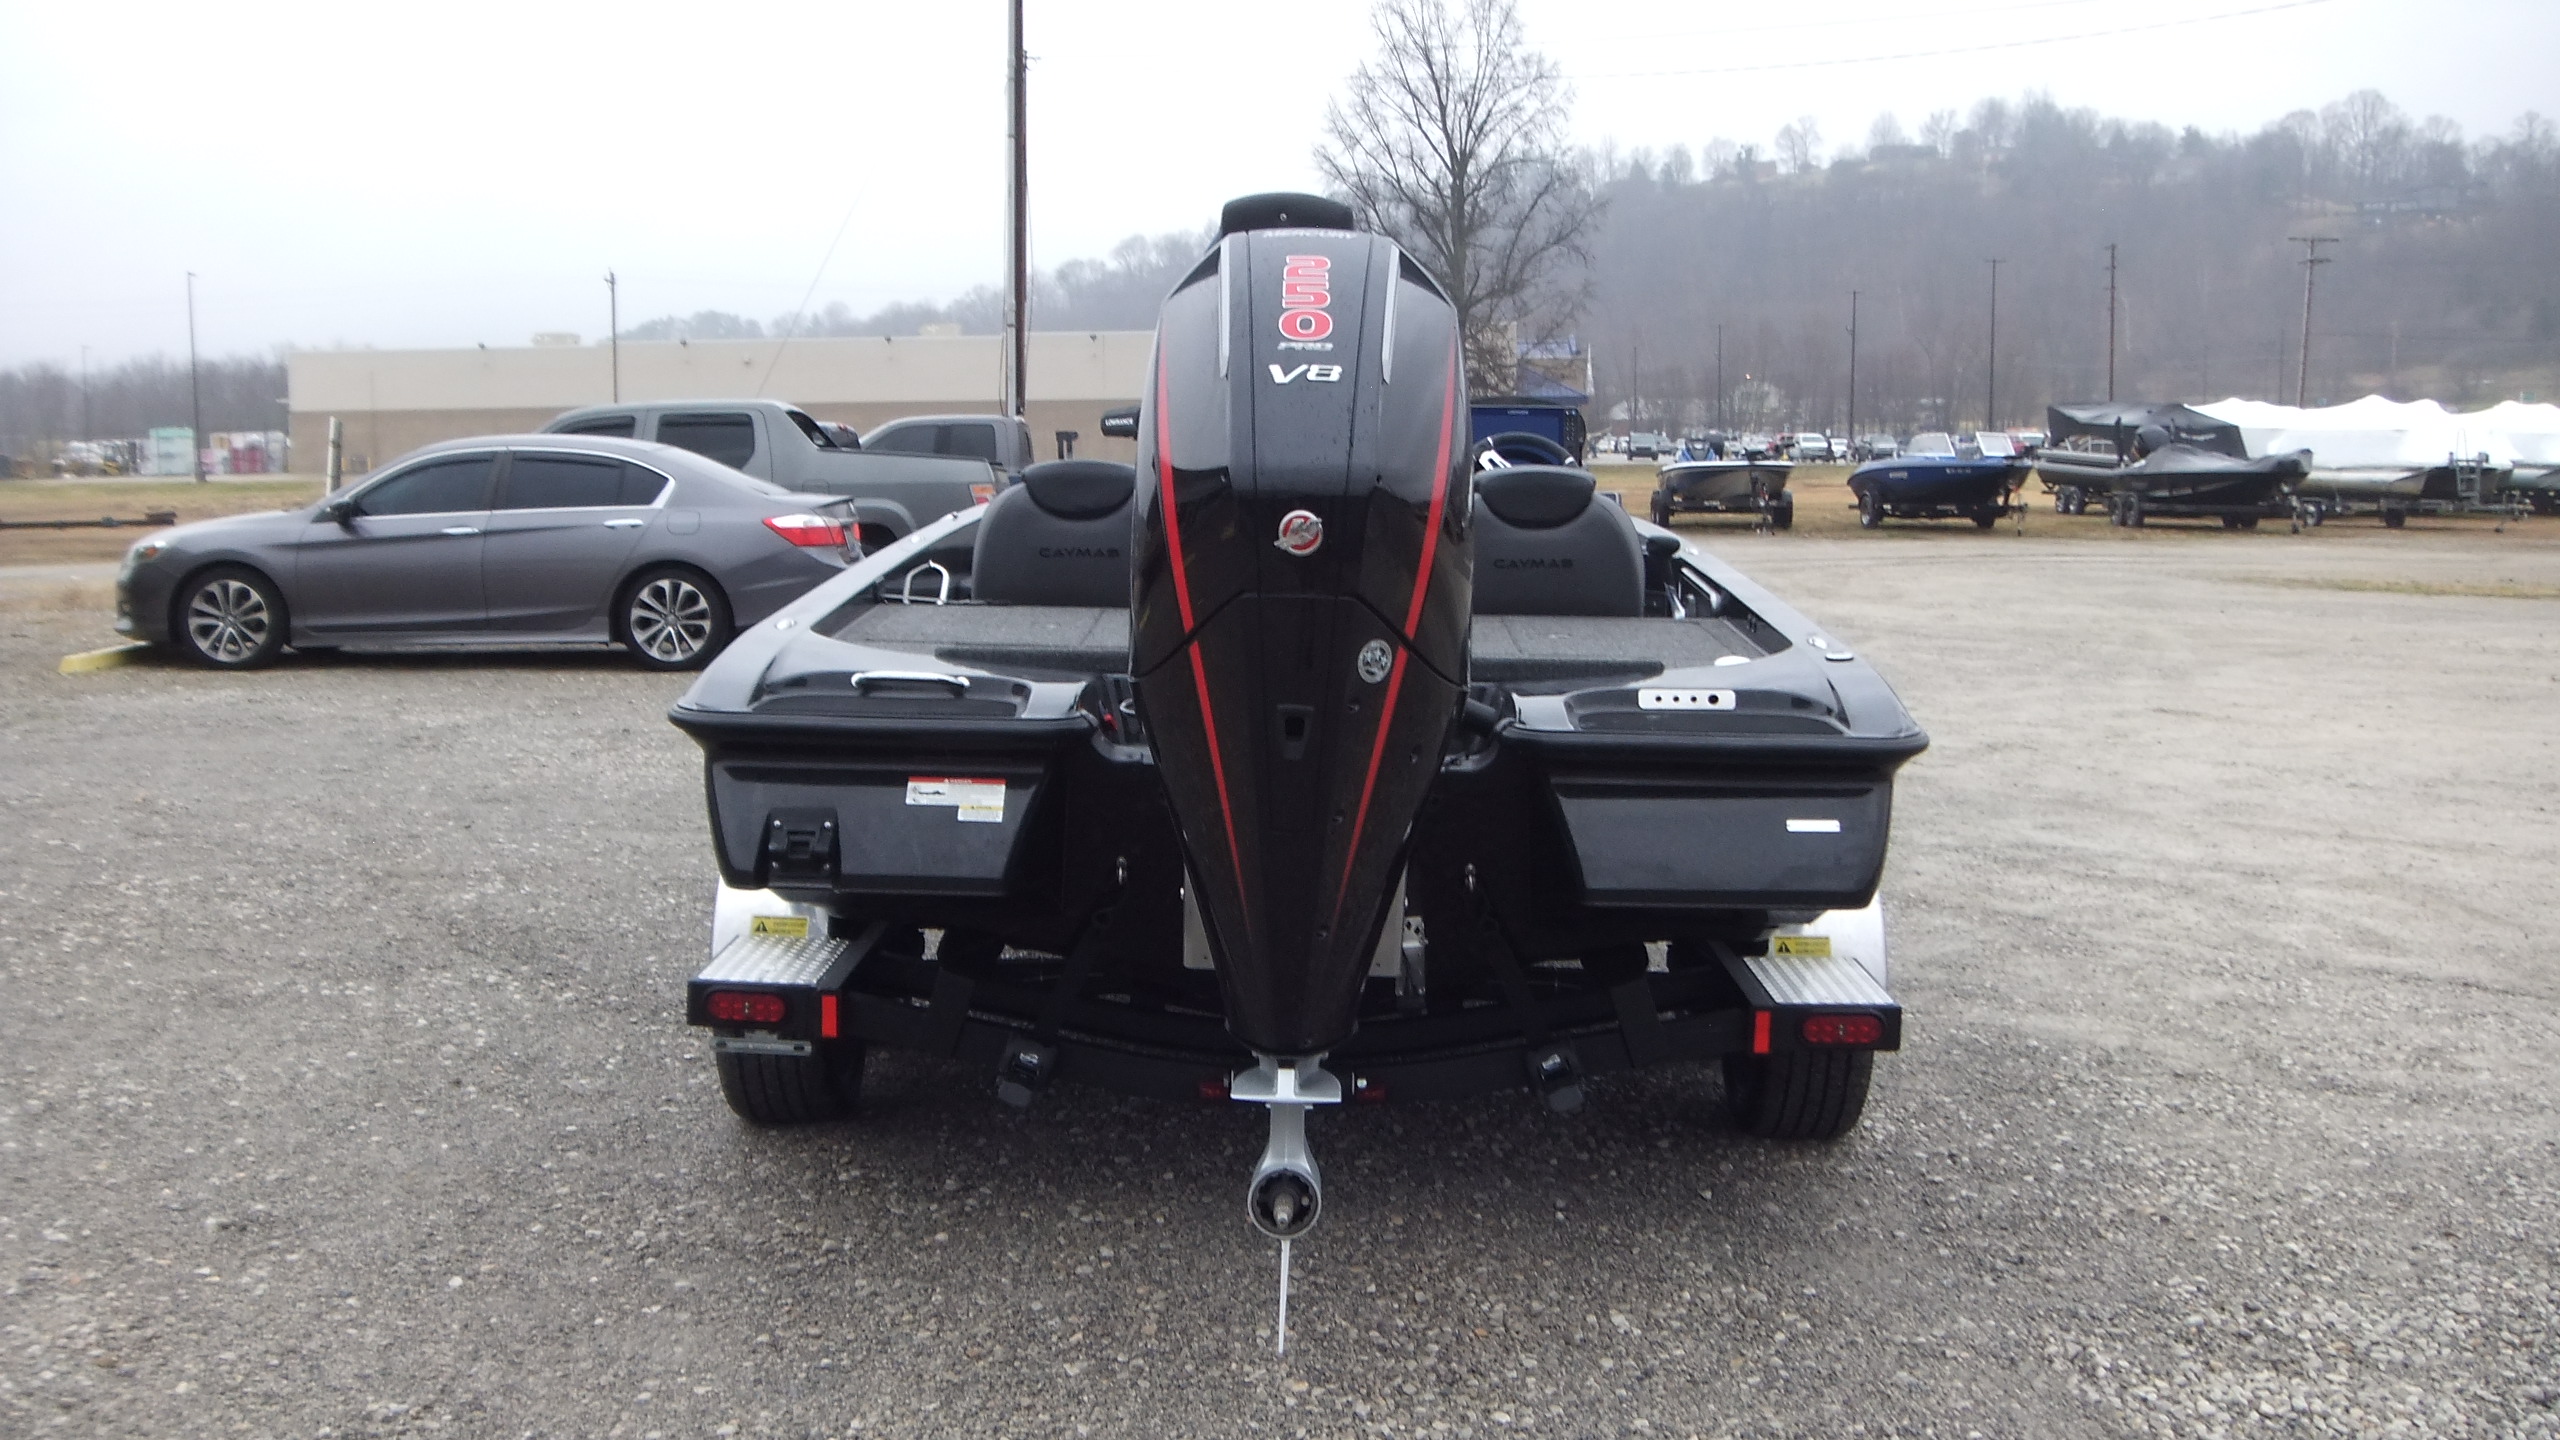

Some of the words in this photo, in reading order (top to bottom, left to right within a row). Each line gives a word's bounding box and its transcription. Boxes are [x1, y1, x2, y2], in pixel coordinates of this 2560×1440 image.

[1278, 255, 1333, 341] 250
[1268, 364, 1343, 384] V8
[1039, 547, 1120, 558] CAYMAS
